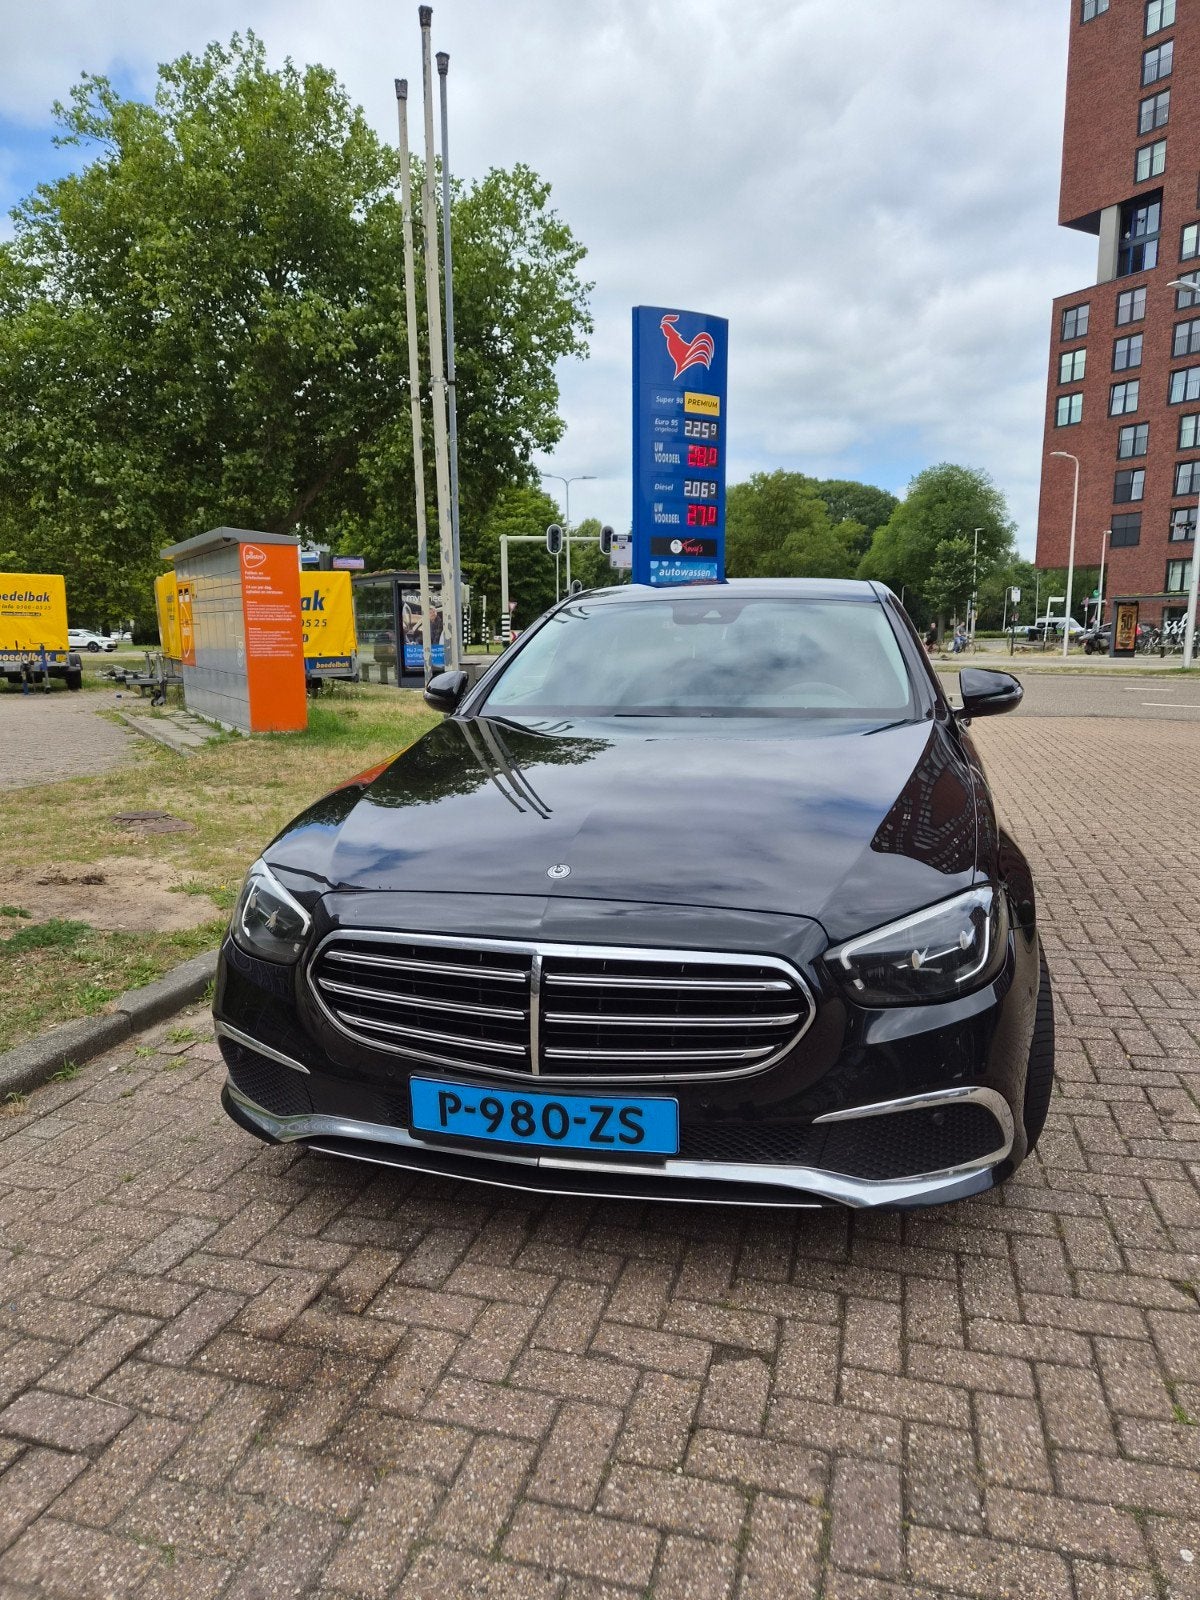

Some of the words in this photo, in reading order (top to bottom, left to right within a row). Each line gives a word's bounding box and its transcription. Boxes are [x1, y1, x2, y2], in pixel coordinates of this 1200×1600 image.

[656, 396, 674, 404] Super
[688, 398, 718, 408] PREMIUM
[654, 442, 664, 452] UW
[654, 453, 680, 464] VOORDEEL
[654, 503, 664, 512] UW
[654, 513, 680, 524] VOORDEEL
[659, 568, 711, 577] autowassen
[0, 591, 50, 602] edelbak
[0, 653, 51, 662] oedelbk
[316, 661, 349, 669] boedelbak
[438, 1090, 645, 1145] P-980-ZS
